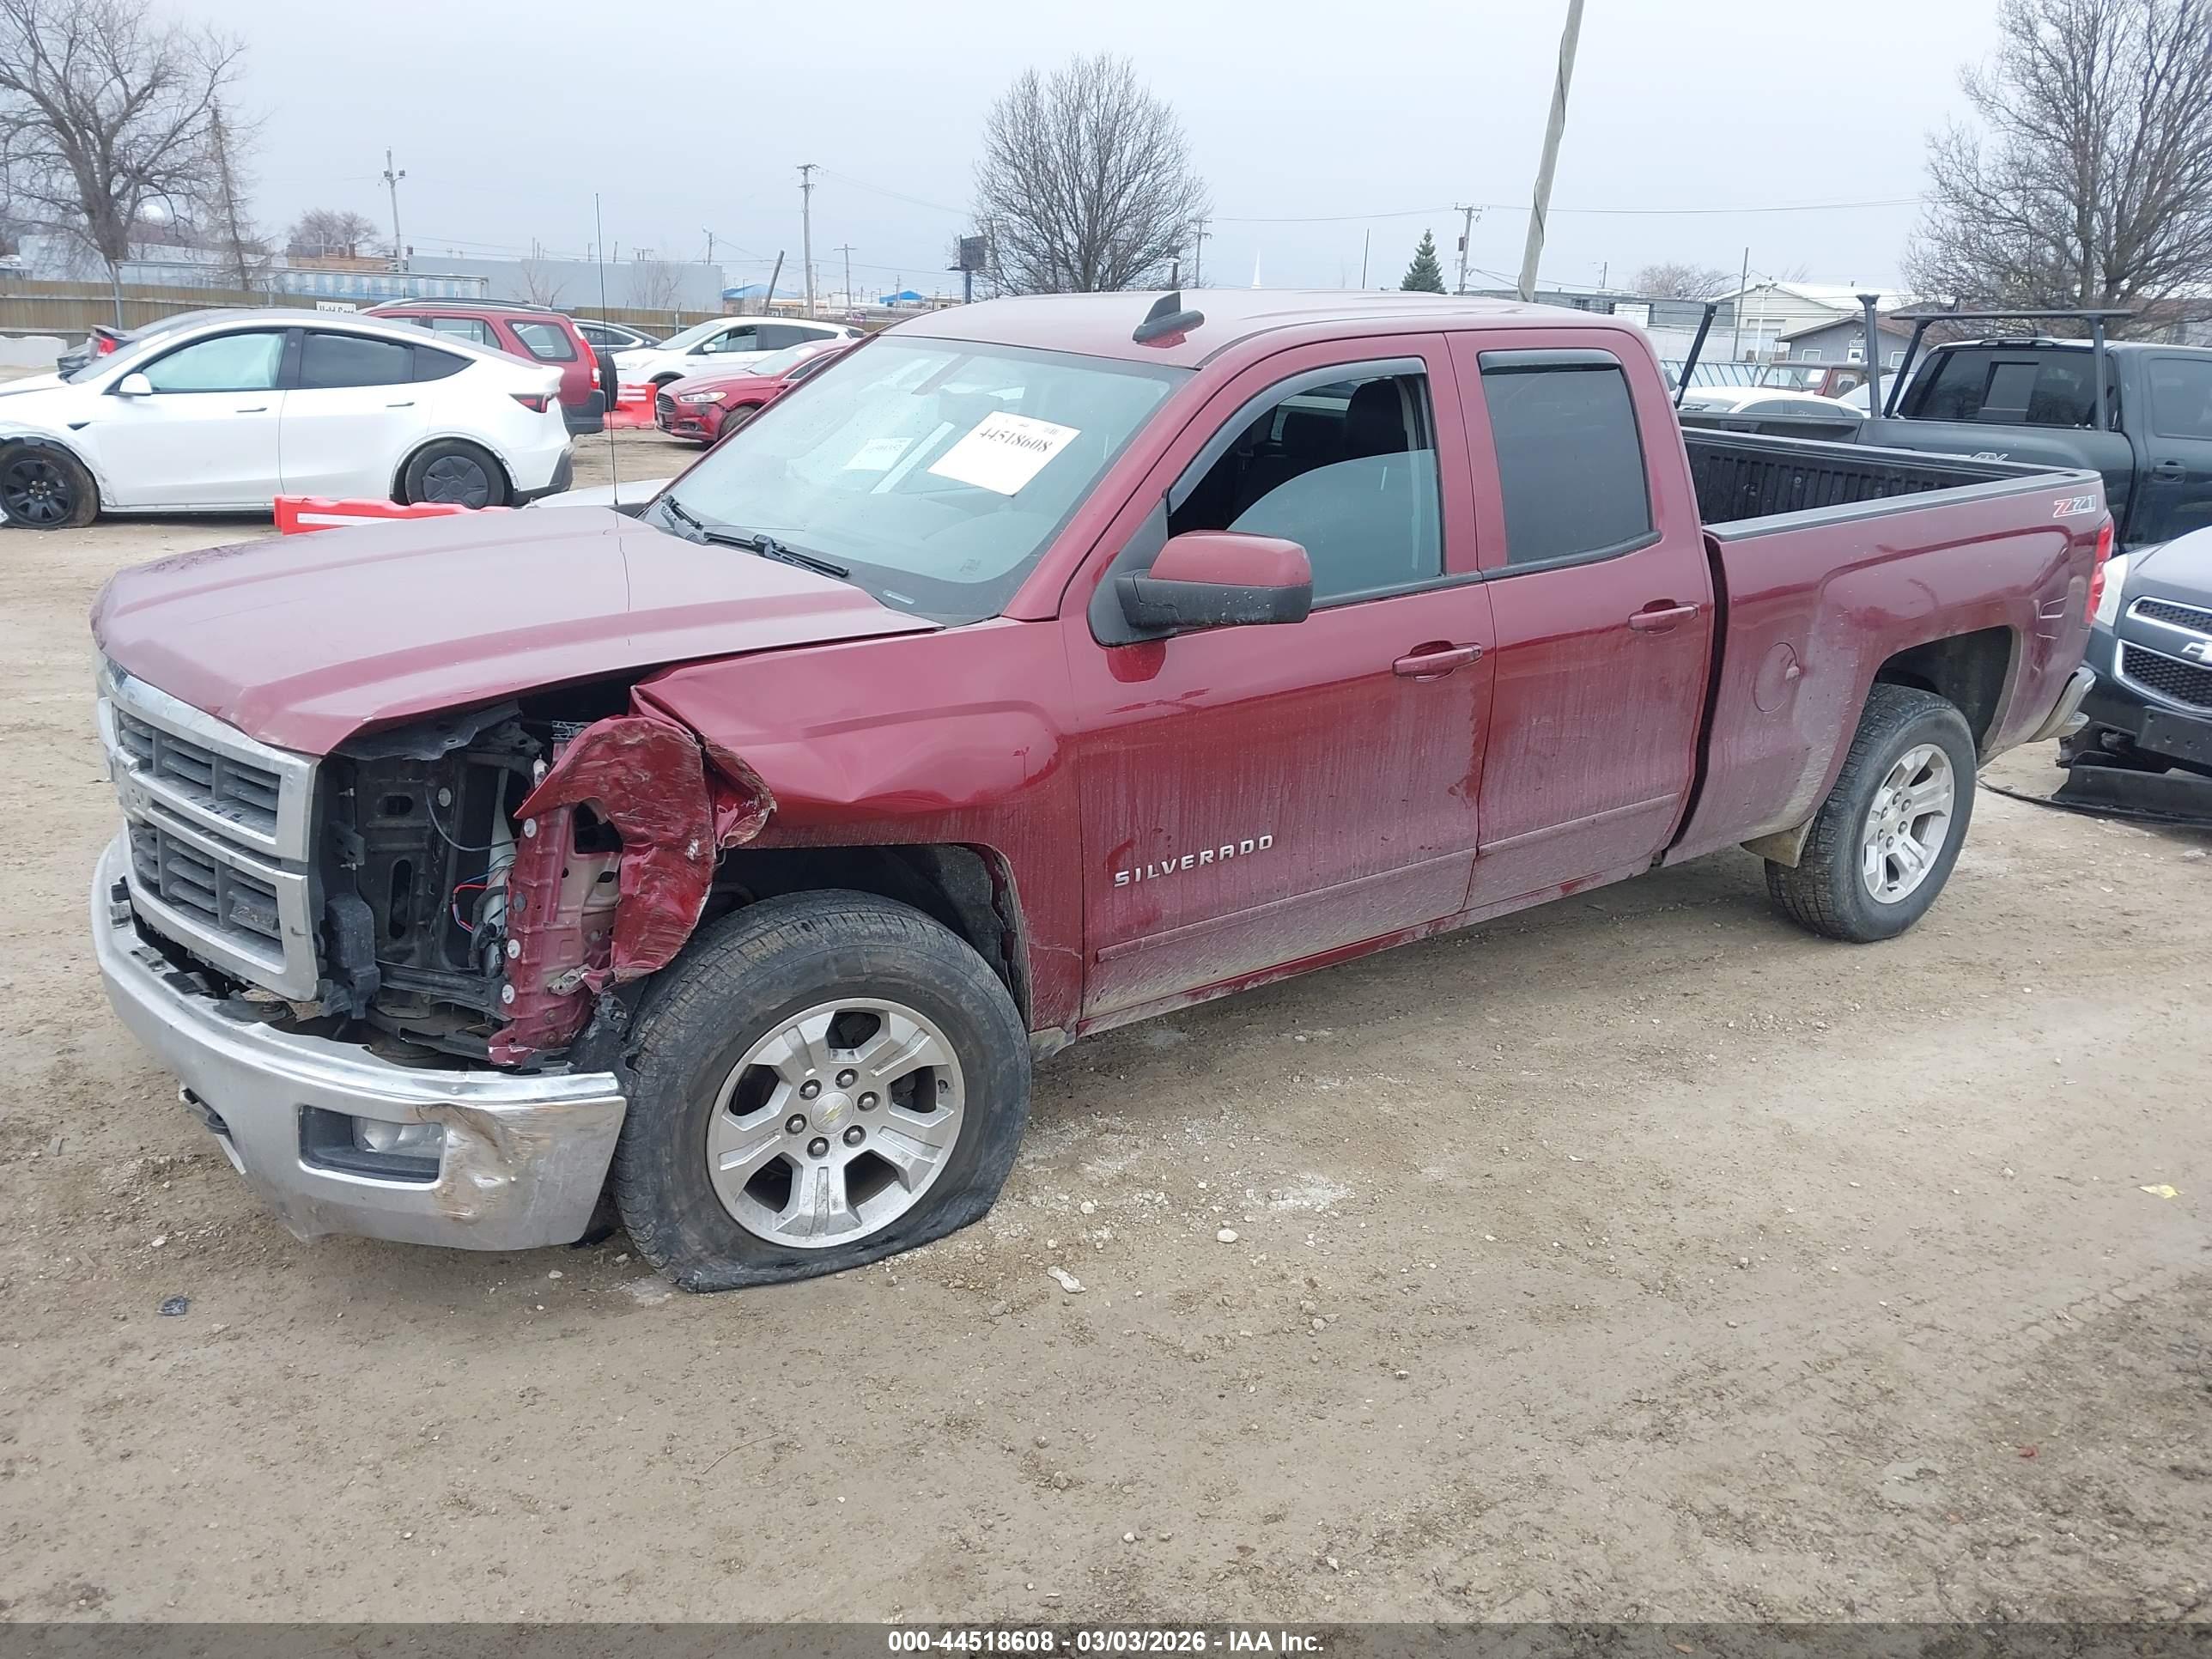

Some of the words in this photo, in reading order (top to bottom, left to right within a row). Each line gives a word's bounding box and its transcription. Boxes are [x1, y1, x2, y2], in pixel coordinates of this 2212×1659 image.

[979, 427, 1054, 453] 44518608
[2052, 494, 2097, 519] Z71
[1114, 834, 1273, 888] SILVERADO
